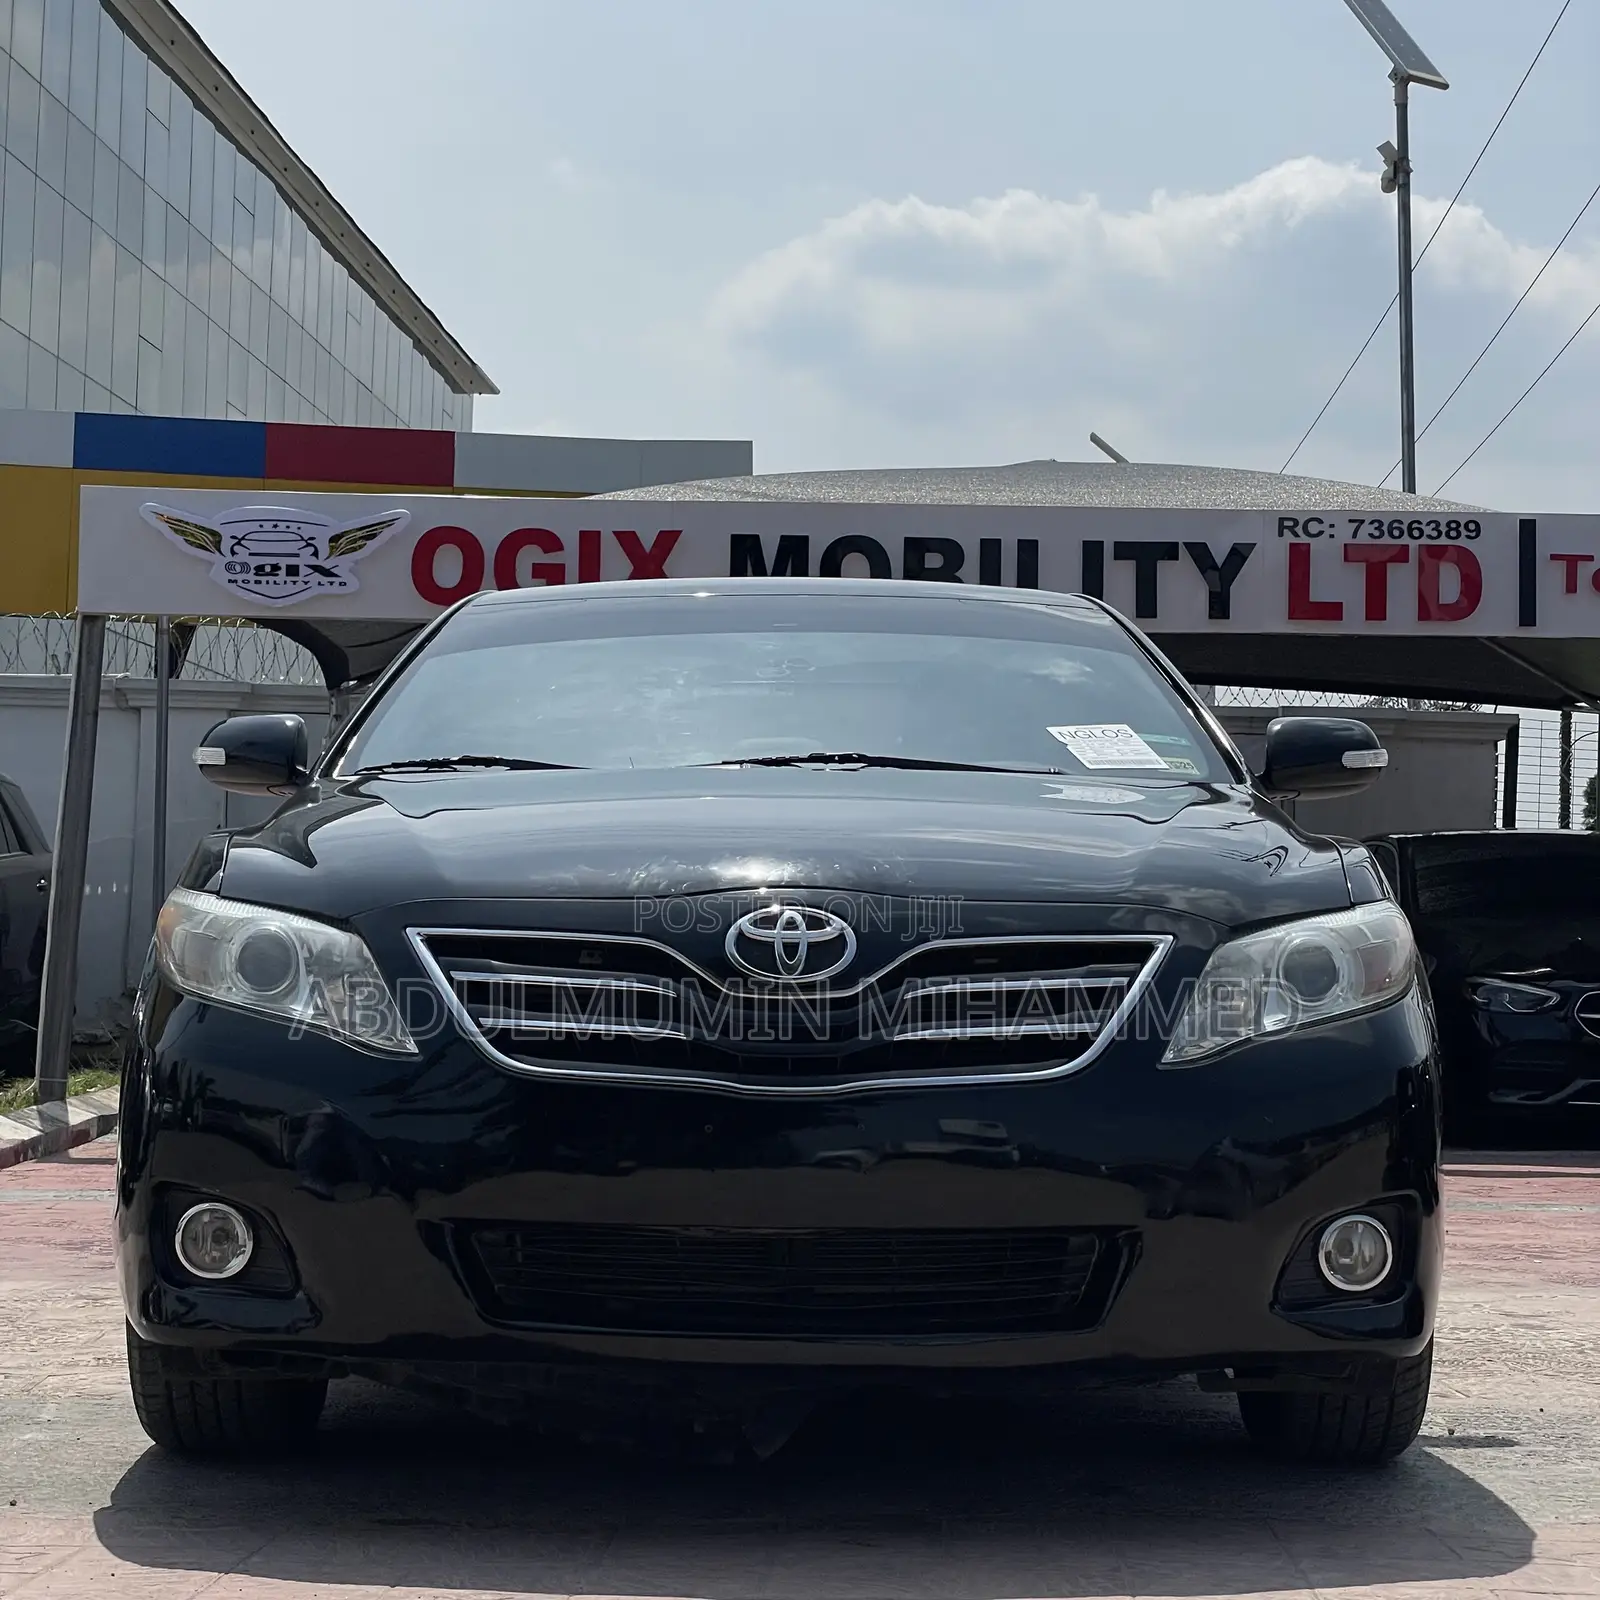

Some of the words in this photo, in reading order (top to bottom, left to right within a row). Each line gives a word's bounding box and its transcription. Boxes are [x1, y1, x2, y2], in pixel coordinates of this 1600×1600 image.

[1276, 516, 1336, 539] RC:
[1347, 518, 1482, 541] 7366389
[227, 578, 311, 587] MOBILITY
[317, 580, 348, 588] LTD
[410, 525, 684, 608] OGIX
[1287, 541, 1483, 622] LTD
[1549, 553, 1600, 597] T
[1058, 728, 1133, 740] NGLOS
